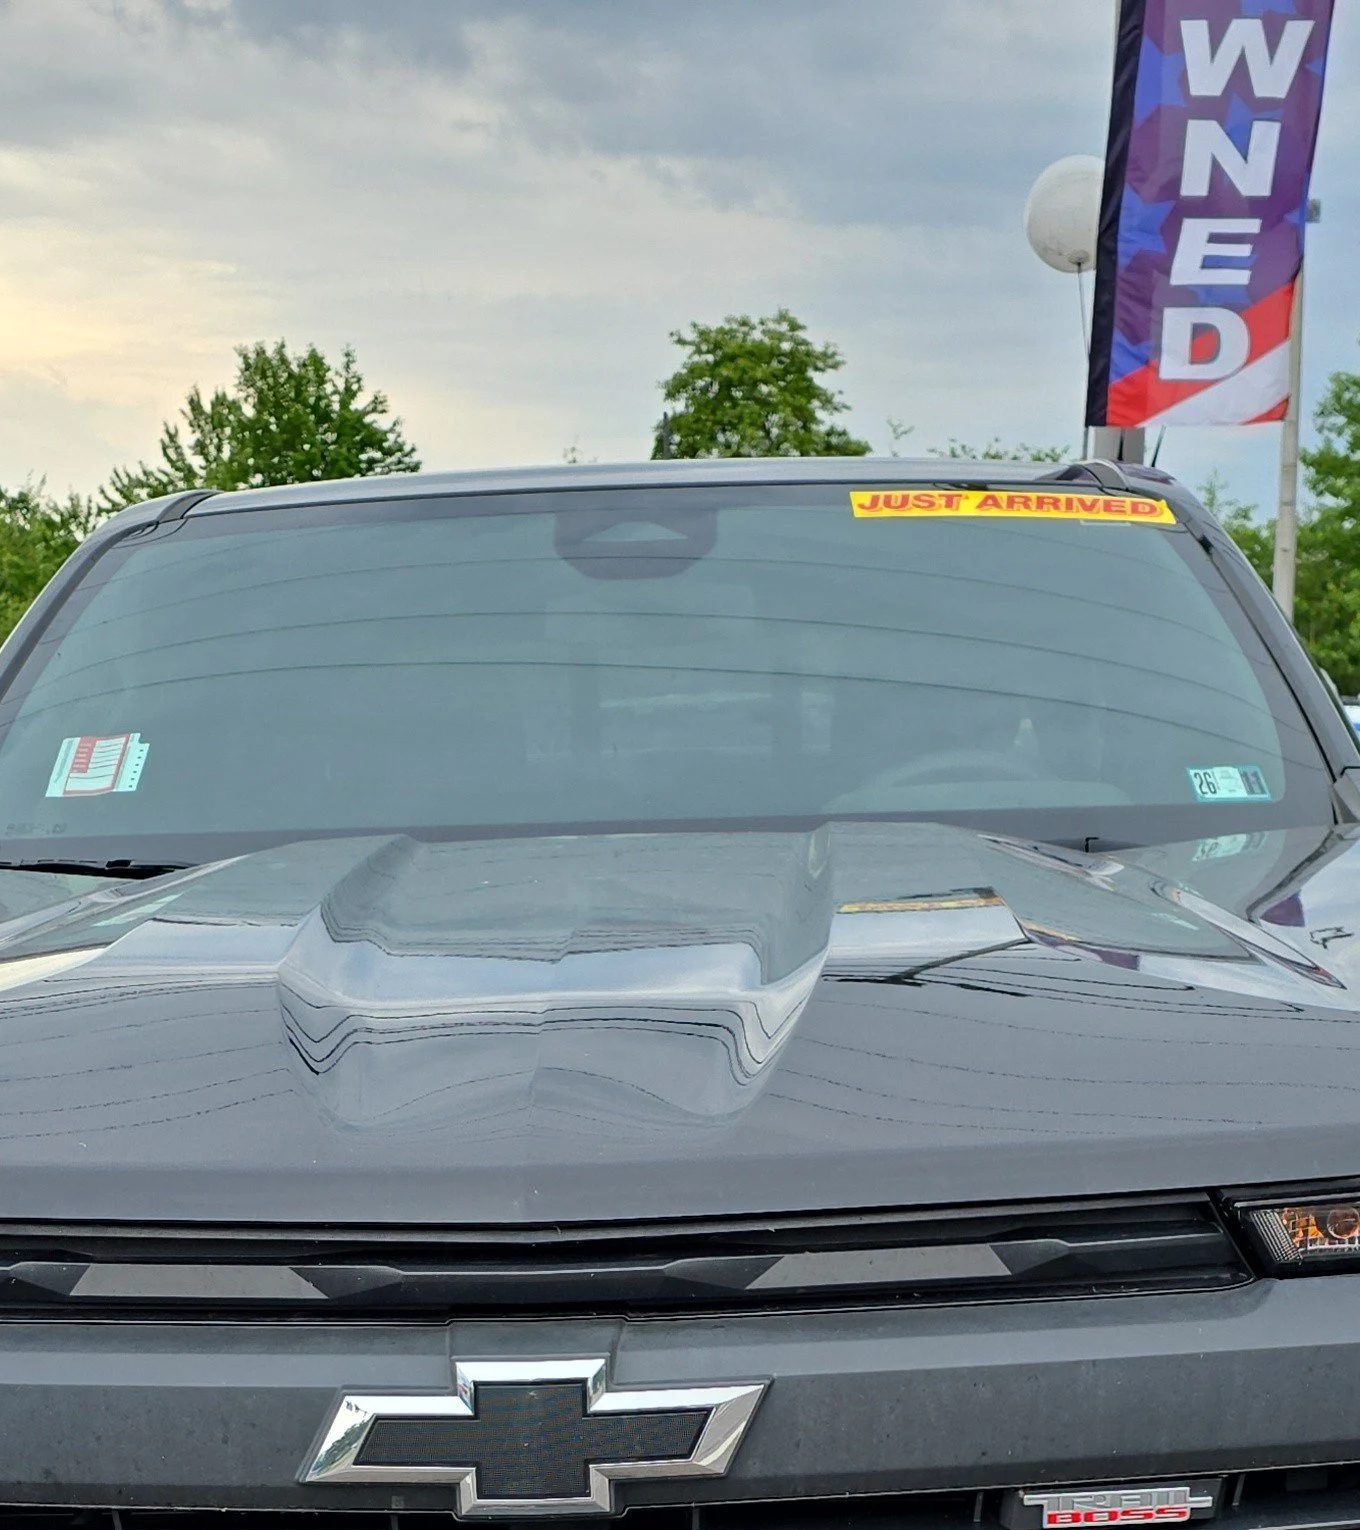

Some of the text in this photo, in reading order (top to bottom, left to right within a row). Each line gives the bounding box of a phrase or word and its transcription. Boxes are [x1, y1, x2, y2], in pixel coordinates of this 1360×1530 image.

[856, 493, 1164, 517] JUST ARRIVED
[1193, 771, 1217, 795] 26
[1047, 1506, 1189, 1525] BOSS
